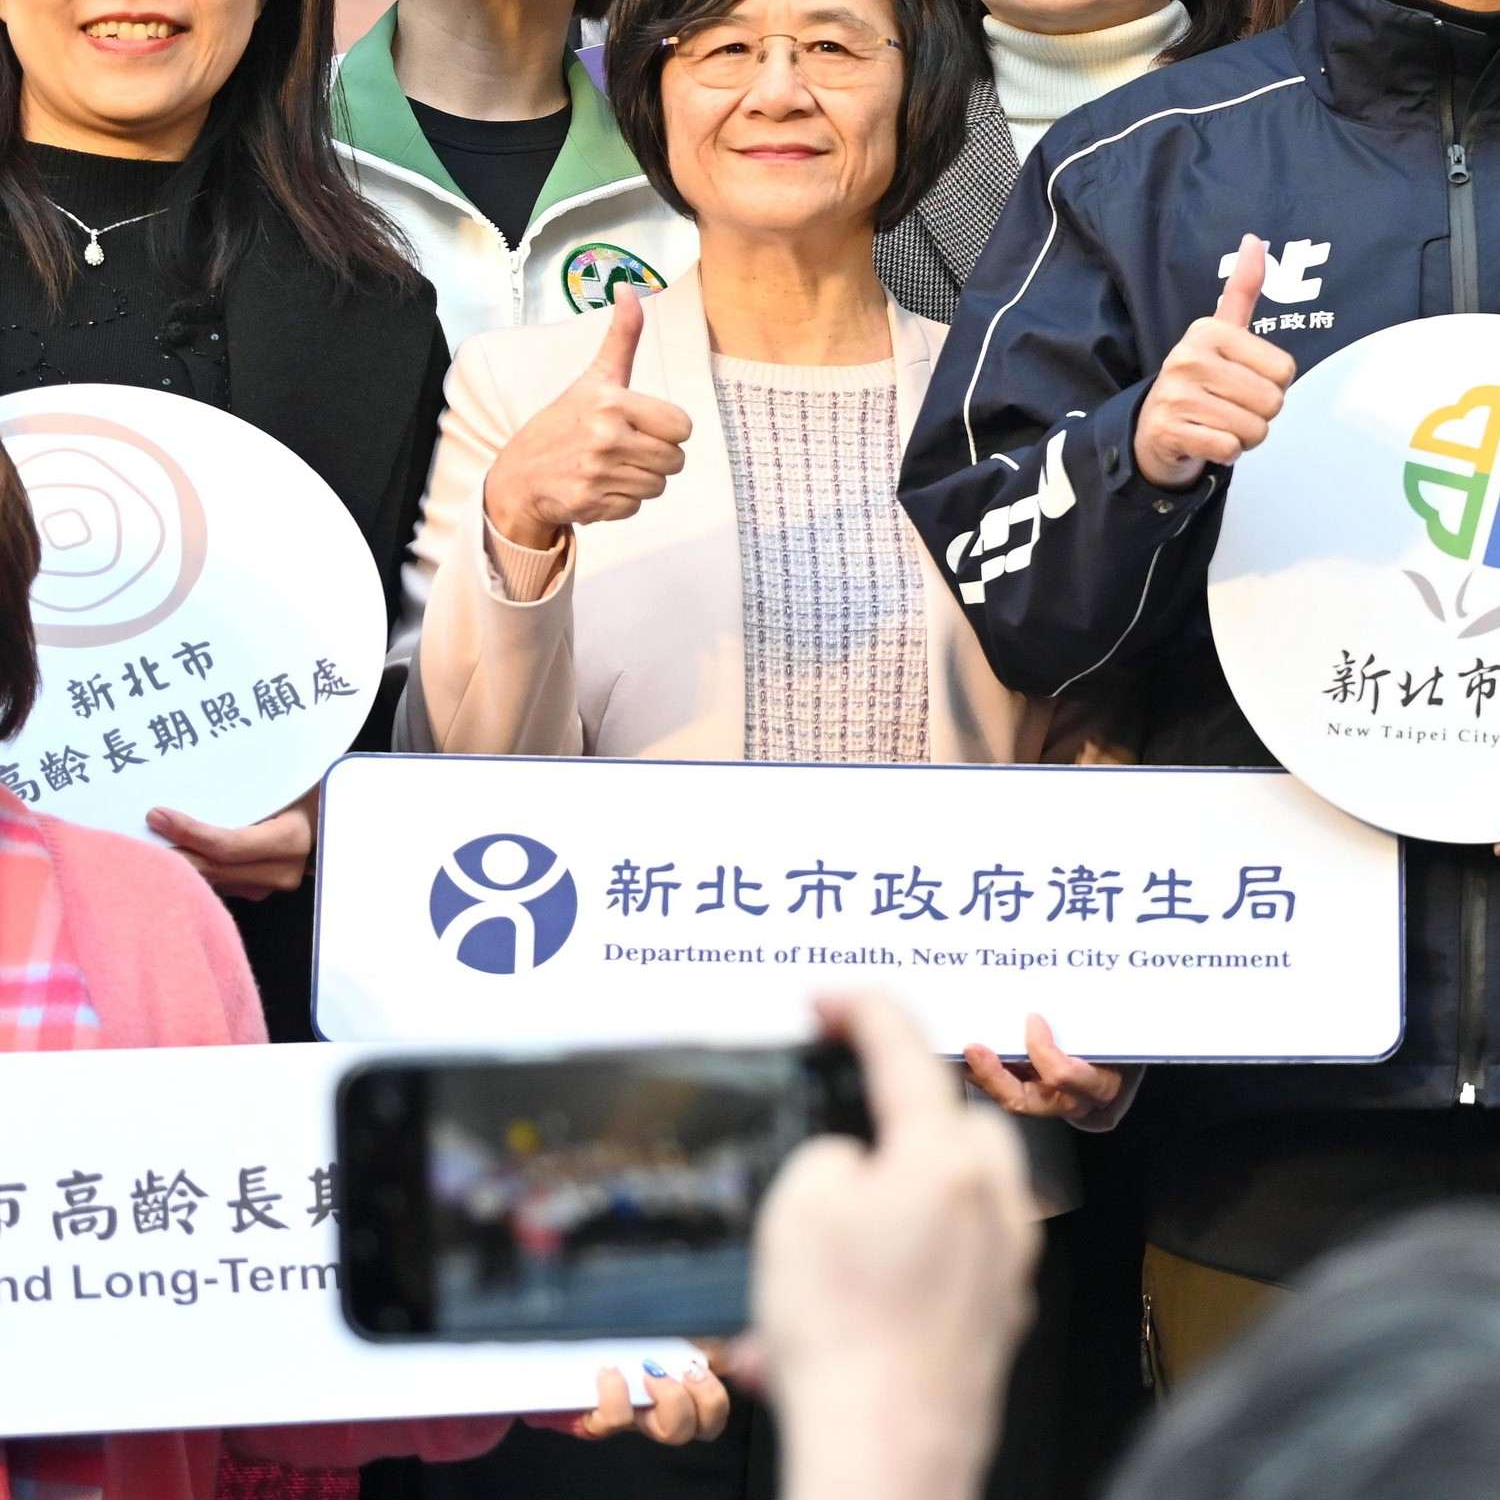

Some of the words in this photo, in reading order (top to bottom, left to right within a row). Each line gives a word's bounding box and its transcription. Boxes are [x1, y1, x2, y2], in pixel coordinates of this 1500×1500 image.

[1252, 311, 1336, 335] 市政府
[67, 640, 214, 719] 新北市
[0, 658, 361, 803] 高齡長期照顧處
[1326, 722, 1370, 737] New
[1381, 724, 1447, 744] Taipei
[1458, 729, 1500, 748] City
[605, 858, 1297, 924] 新北市政府衛生局
[603, 943, 765, 966] Department
[774, 945, 801, 964] of
[806, 946, 903, 967] Health,
[912, 947, 969, 966] New
[976, 947, 1058, 970] Taipei
[1067, 949, 1120, 971] City
[1128, 949, 1292, 968] Government
[72, 1257, 341, 1306] Long-Term
